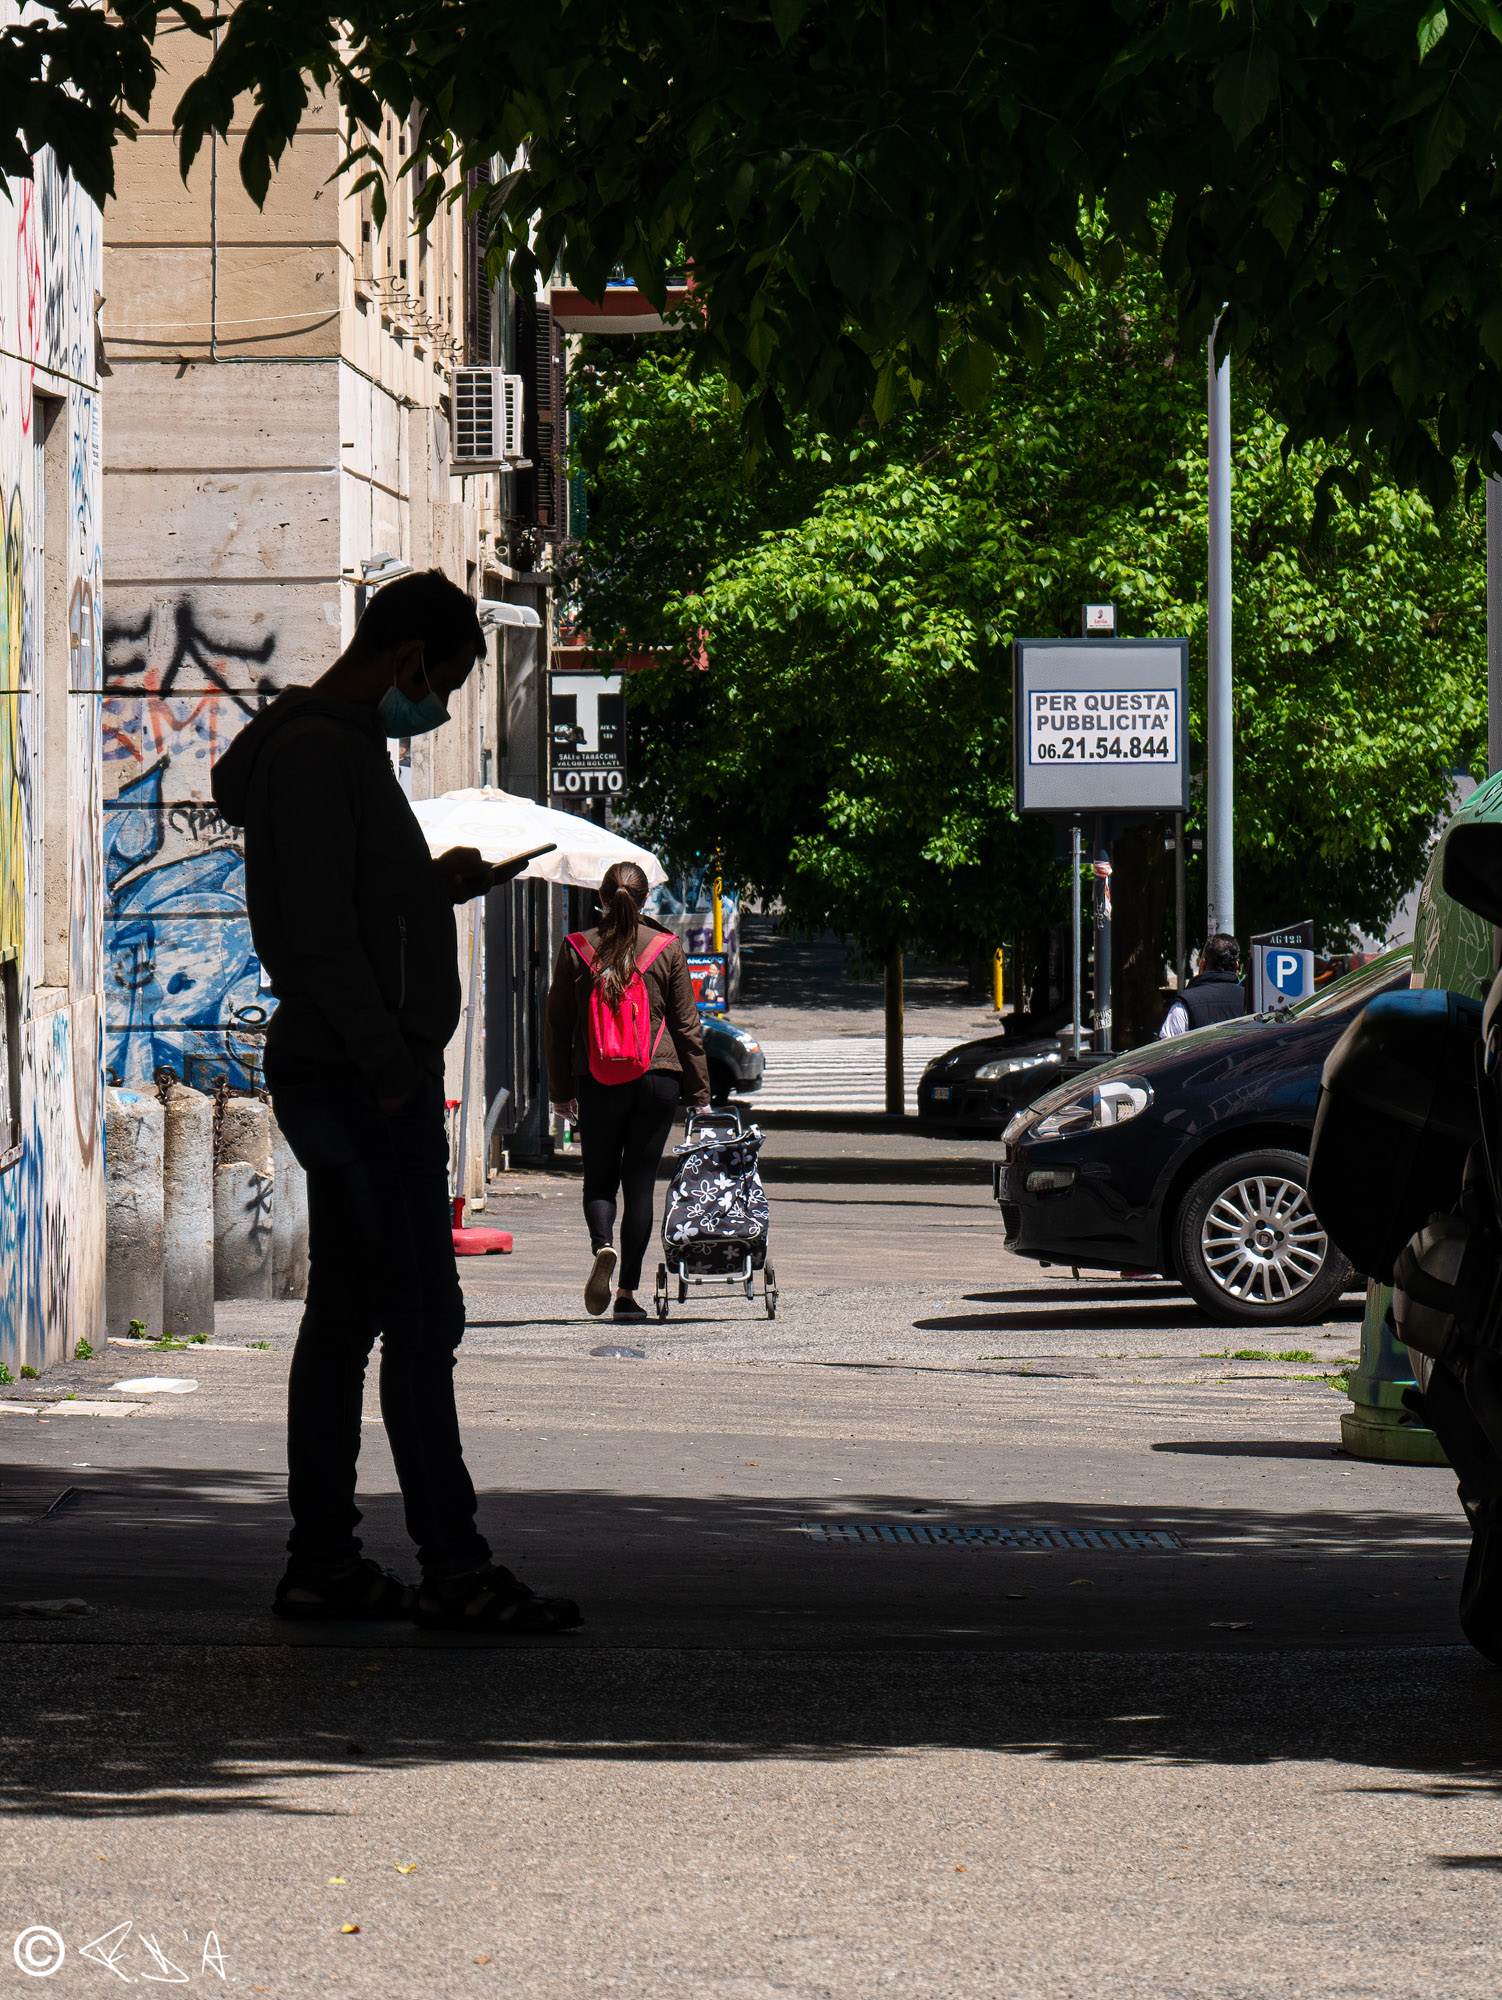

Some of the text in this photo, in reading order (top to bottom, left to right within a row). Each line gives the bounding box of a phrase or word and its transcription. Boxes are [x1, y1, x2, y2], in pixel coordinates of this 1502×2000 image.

[551, 675, 622, 752] T
[1035, 694, 1170, 711] PER QUESTA
[1036, 714, 1169, 731] PUBBLICITA'
[1037, 736, 1169, 759] 06.21.54.844
[553, 771, 623, 792] LOTTO
[1276, 955, 1298, 988] P
